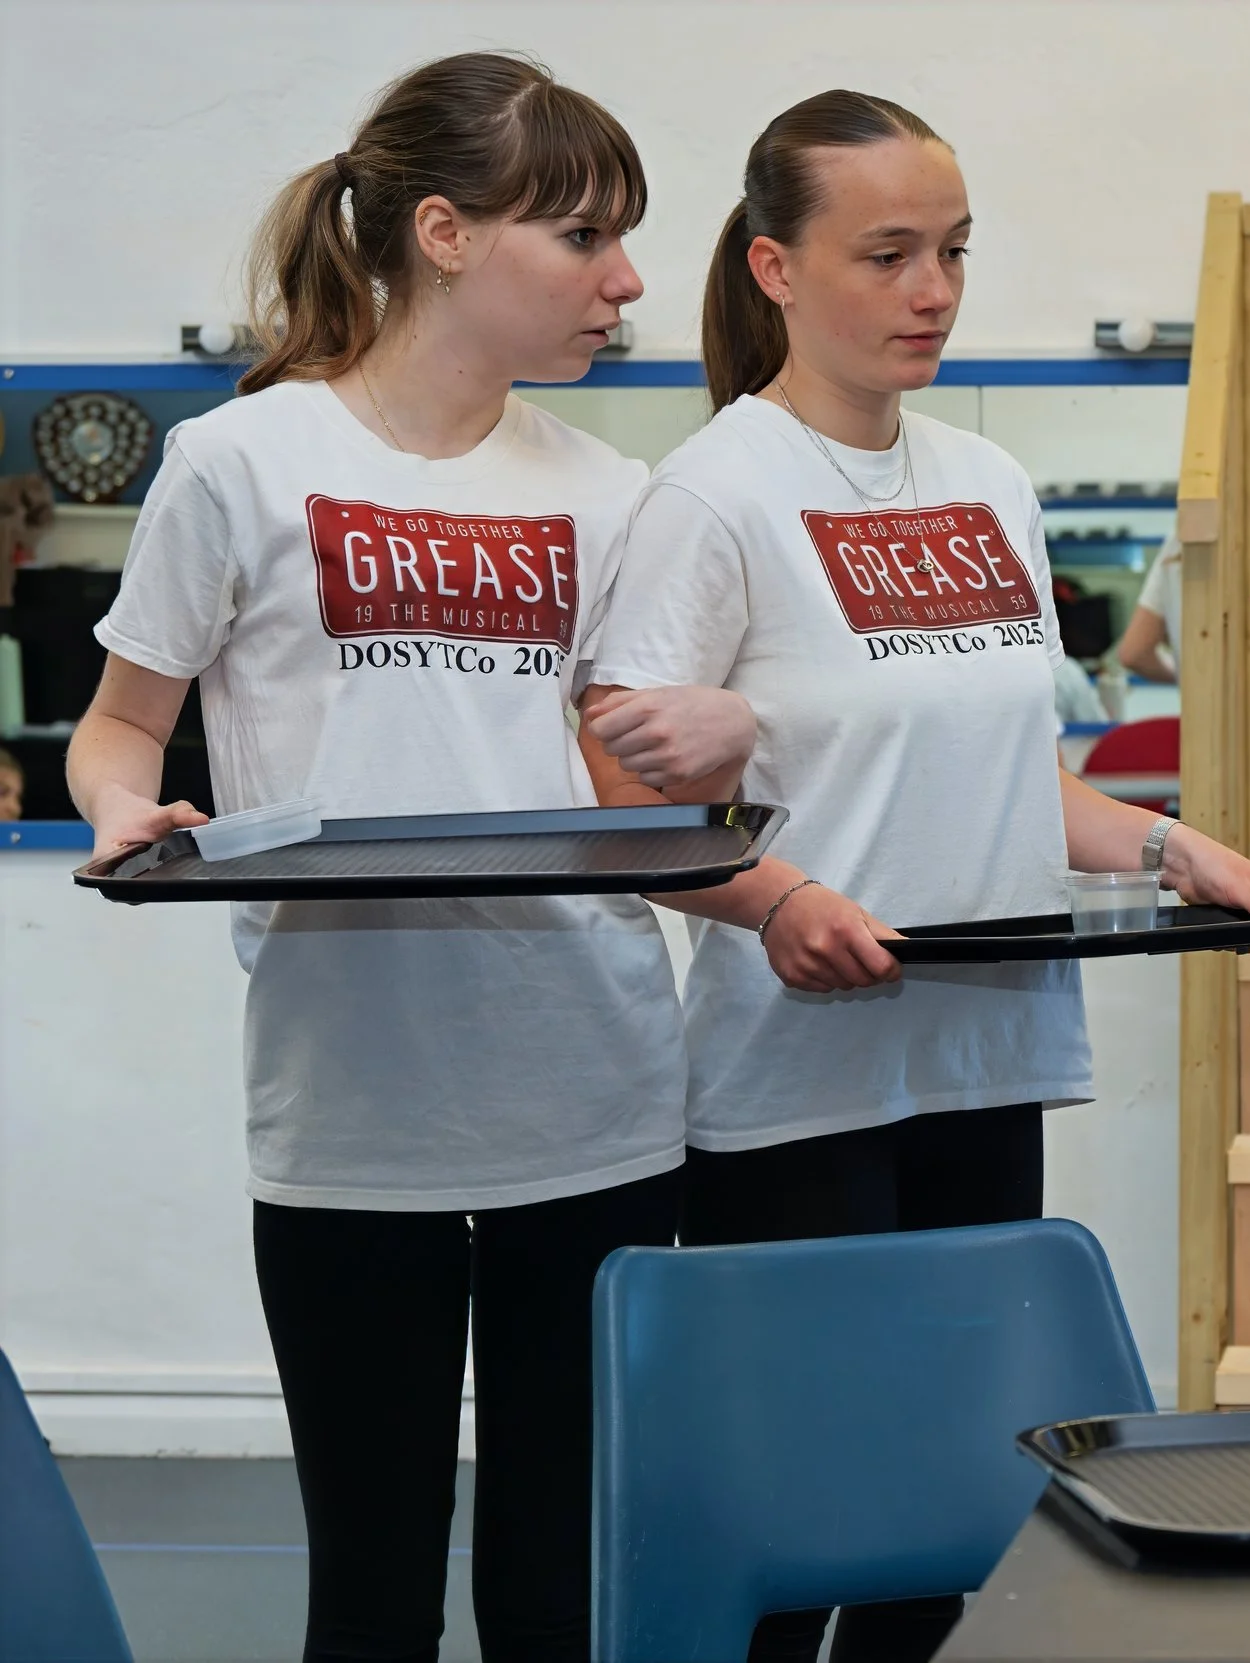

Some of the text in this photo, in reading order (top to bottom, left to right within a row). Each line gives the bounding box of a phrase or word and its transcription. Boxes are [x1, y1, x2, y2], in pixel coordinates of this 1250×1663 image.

[373, 512, 524, 539] WE GO TOGETHER
[843, 515, 958, 539] WE GO TOGETHER
[343, 531, 569, 611] GREASE
[837, 535, 1016, 598] GREASE
[355, 605, 373, 623] 19
[390, 604, 430, 622] THE
[443, 608, 540, 632] MUSICAL
[869, 594, 1027, 621] 19 THE MUSICAL 59
[864, 622, 1045, 660] DOSYTCo 2025
[338, 640, 495, 674] DOSYTCo
